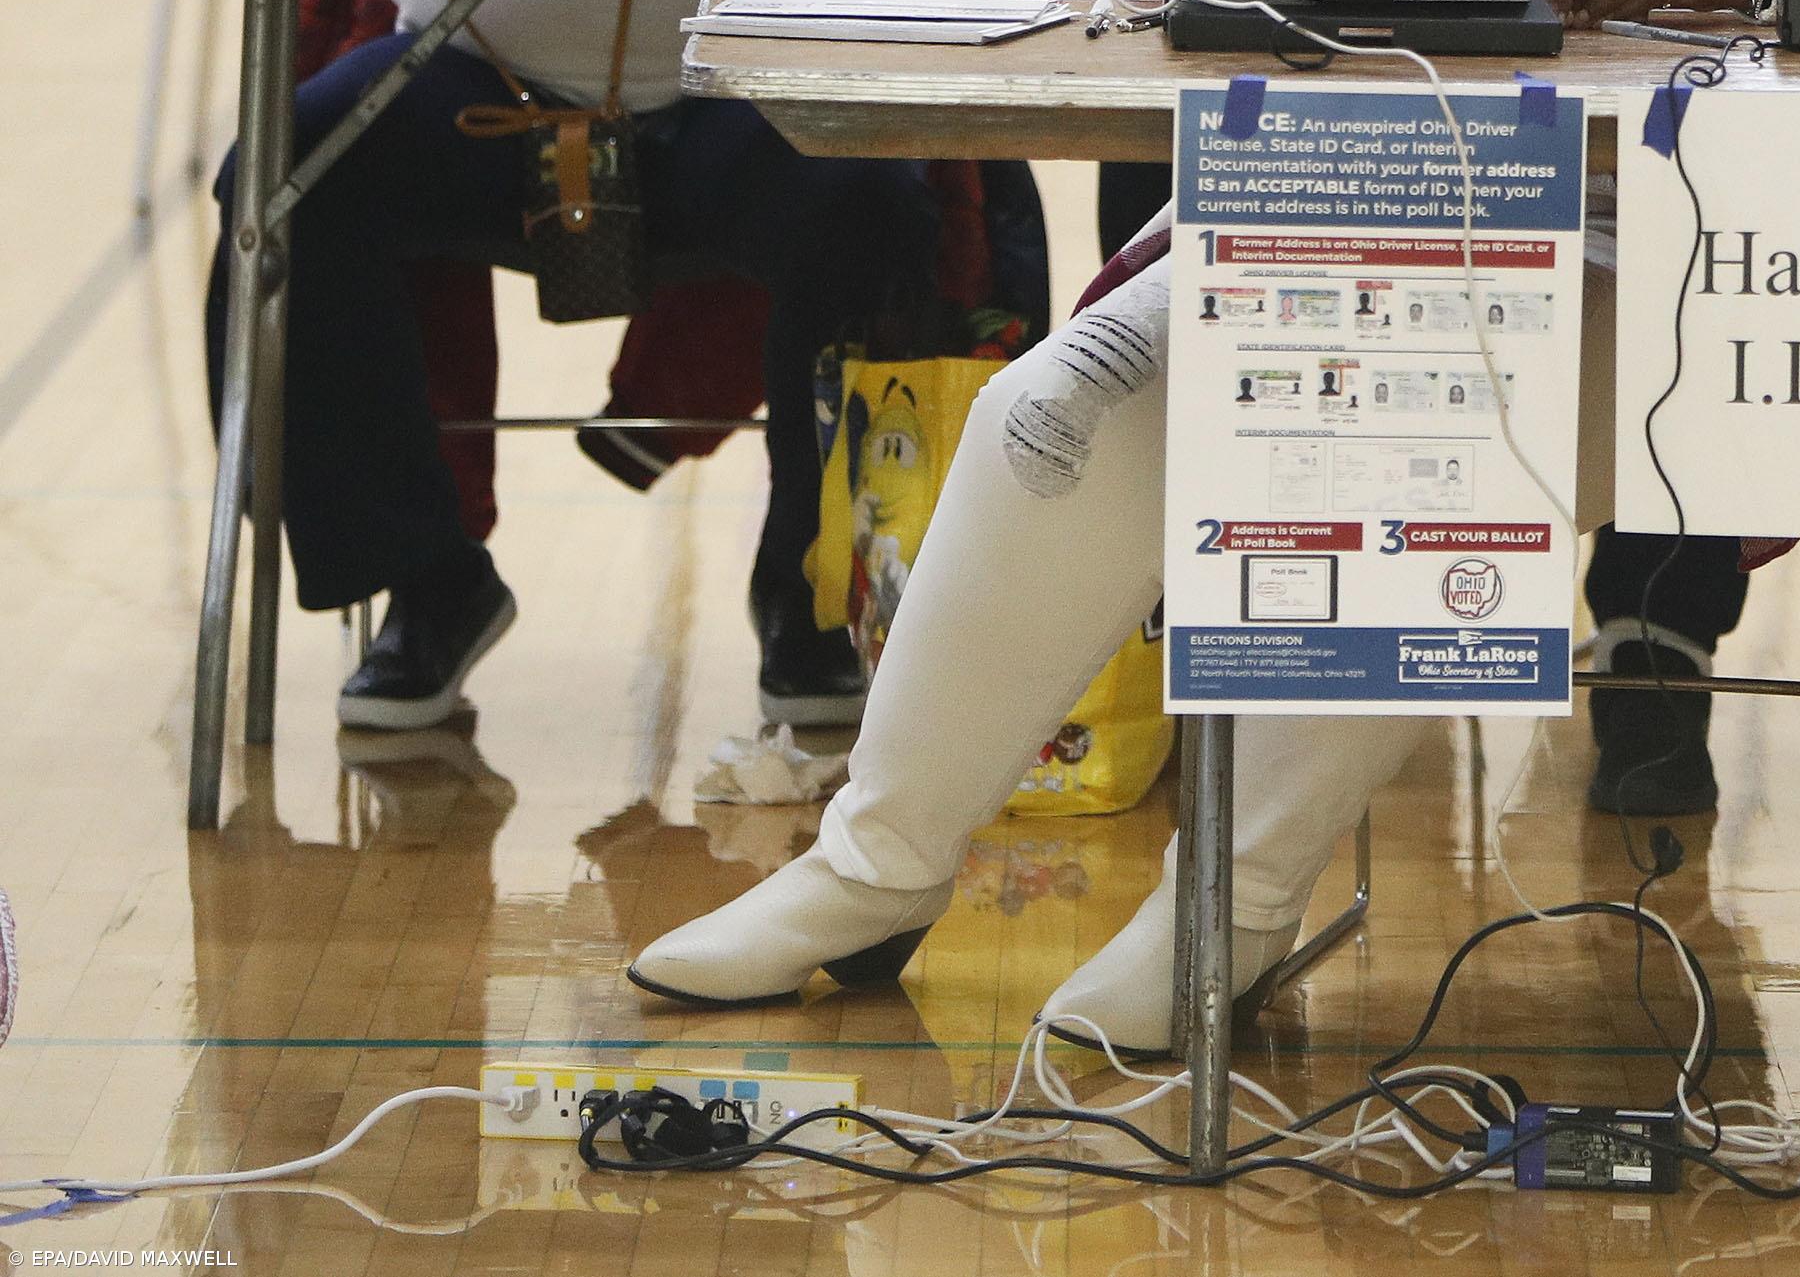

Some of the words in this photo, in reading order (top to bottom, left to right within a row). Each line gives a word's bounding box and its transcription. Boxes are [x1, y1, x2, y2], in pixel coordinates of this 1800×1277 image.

[1199, 111, 1297, 132] NCE:
[1301, 119, 1325, 133] An
[1329, 120, 1416, 136] unexpired
[1466, 122, 1518, 137] Driver
[1199, 137, 1266, 153] License,
[1269, 138, 1315, 153] State
[1319, 139, 1338, 154] ID
[1390, 143, 1408, 155] or
[1199, 158, 1333, 174] Documentation
[1337, 160, 1376, 174] with
[1381, 163, 1419, 177] your
[1423, 161, 1484, 177] former
[1486, 163, 1557, 178] address
[1198, 178, 1215, 192] IS
[1218, 181, 1241, 192] an
[1244, 179, 1360, 195] ACCEPTABLE
[1364, 180, 1405, 196] form
[1408, 182, 1427, 196] of
[1430, 183, 1449, 197] ID
[1504, 186, 1544, 201] your
[1197, 200, 1261, 213] current
[1264, 200, 1332, 214] address
[1335, 200, 1349, 215] is
[1352, 201, 1369, 215] in
[1373, 202, 1402, 215] the
[1406, 202, 1439, 219] poll
[1198, 230, 1215, 266] 1
[1232, 238, 1273, 248] Former
[1275, 238, 1320, 249] Address
[1322, 238, 1332, 249] is
[1333, 241, 1348, 250] on
[1350, 240, 1376, 250] Ohio
[1379, 240, 1413, 250] Driver
[1415, 241, 1459, 252] License,
[1460, 241, 1490, 252] Sate
[1491, 242, 1505, 252] ID
[1506, 242, 1535, 254] Card,
[1536, 244, 1549, 253] or
[1232, 252, 1273, 261] Interim
[1275, 252, 1362, 262] Documentation
[1268, 429, 1336, 437] DOCUMENTATION
[1195, 519, 1223, 555] 2
[1231, 526, 1276, 535] Address
[1278, 526, 1288, 535] is
[1289, 526, 1332, 535] Current
[1379, 520, 1405, 555] 3
[1410, 531, 1447, 542] CAST
[1449, 531, 1488, 543] YOUR
[1491, 531, 1545, 543] BALLOT
[1231, 539, 1242, 548] in
[1244, 539, 1266, 548] Poll
[1267, 539, 1296, 548] Book
[1456, 576, 1486, 590] OHIO
[1450, 590, 1483, 605] VOTED
[1190, 636, 1251, 645] ELECTIONS
[1253, 636, 1303, 645] DIVISION
[1399, 646, 1461, 662] Frank
[1465, 646, 1539, 662] LaRose
[1418, 664, 1441, 676] Ohio
[1441, 664, 1484, 679] Secretary
[1484, 666, 1495, 679] of
[1494, 664, 1520, 677] State
